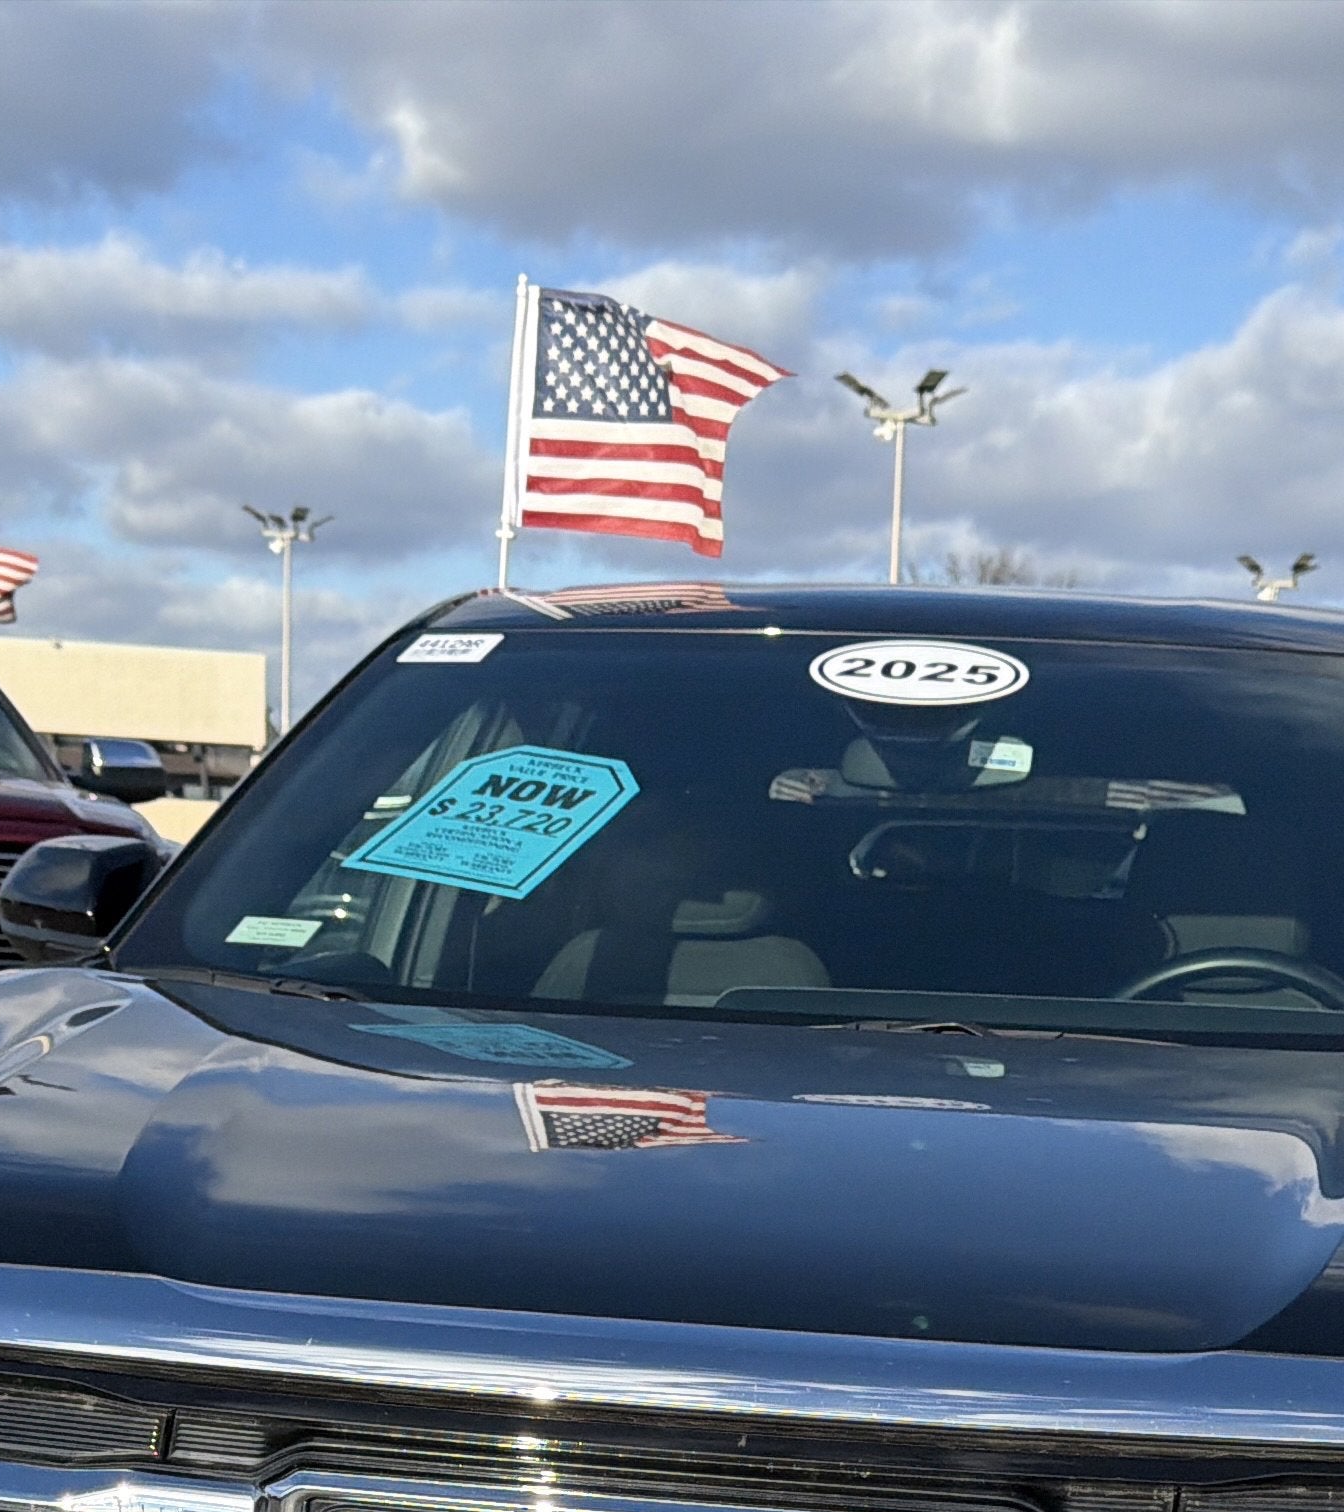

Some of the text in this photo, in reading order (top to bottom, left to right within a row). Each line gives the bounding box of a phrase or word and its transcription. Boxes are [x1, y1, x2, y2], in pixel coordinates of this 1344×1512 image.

[835, 657, 1001, 685] 2025
[471, 774, 596, 810] NOW
[428, 798, 572, 835] $ 23,720
